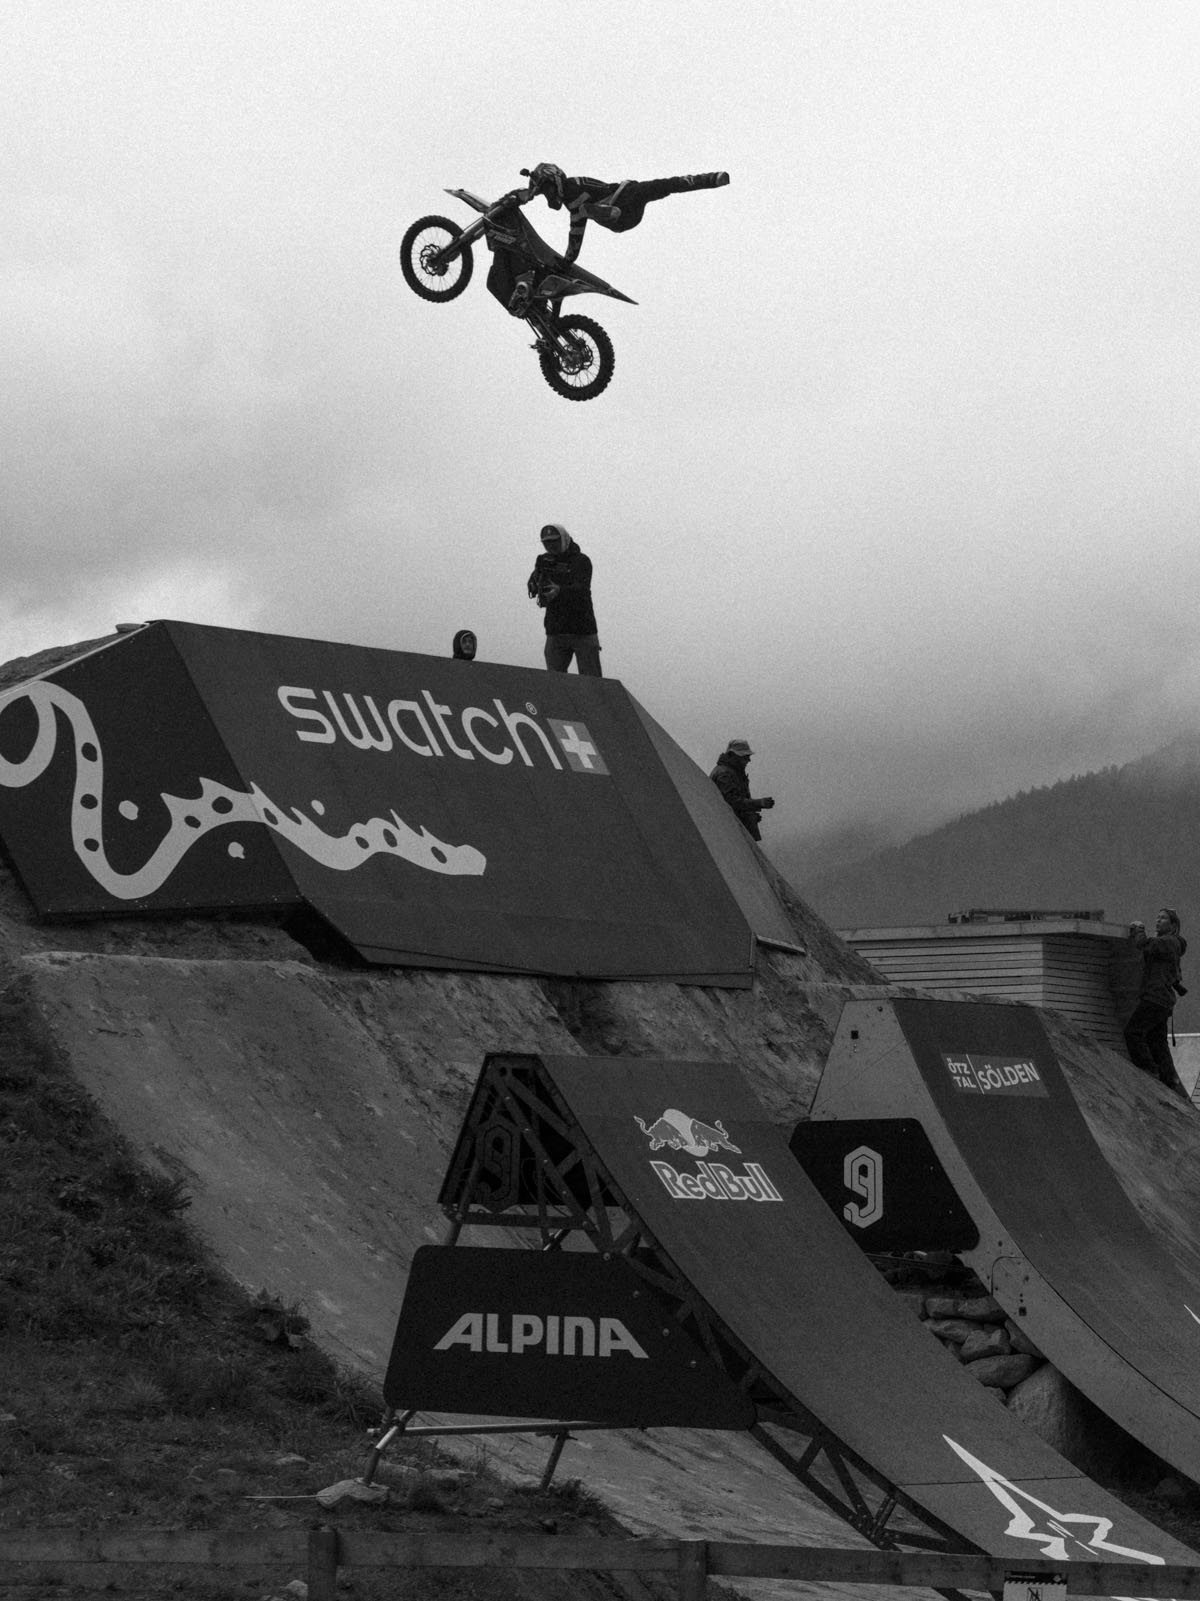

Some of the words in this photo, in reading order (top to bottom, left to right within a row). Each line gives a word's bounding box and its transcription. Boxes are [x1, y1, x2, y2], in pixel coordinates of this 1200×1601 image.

[946, 1057, 971, 1075] ÖTZ
[977, 1062, 1041, 1090] SÖLDEN
[953, 1076, 977, 1088] TAL
[433, 1312, 649, 1360] ALPINA
